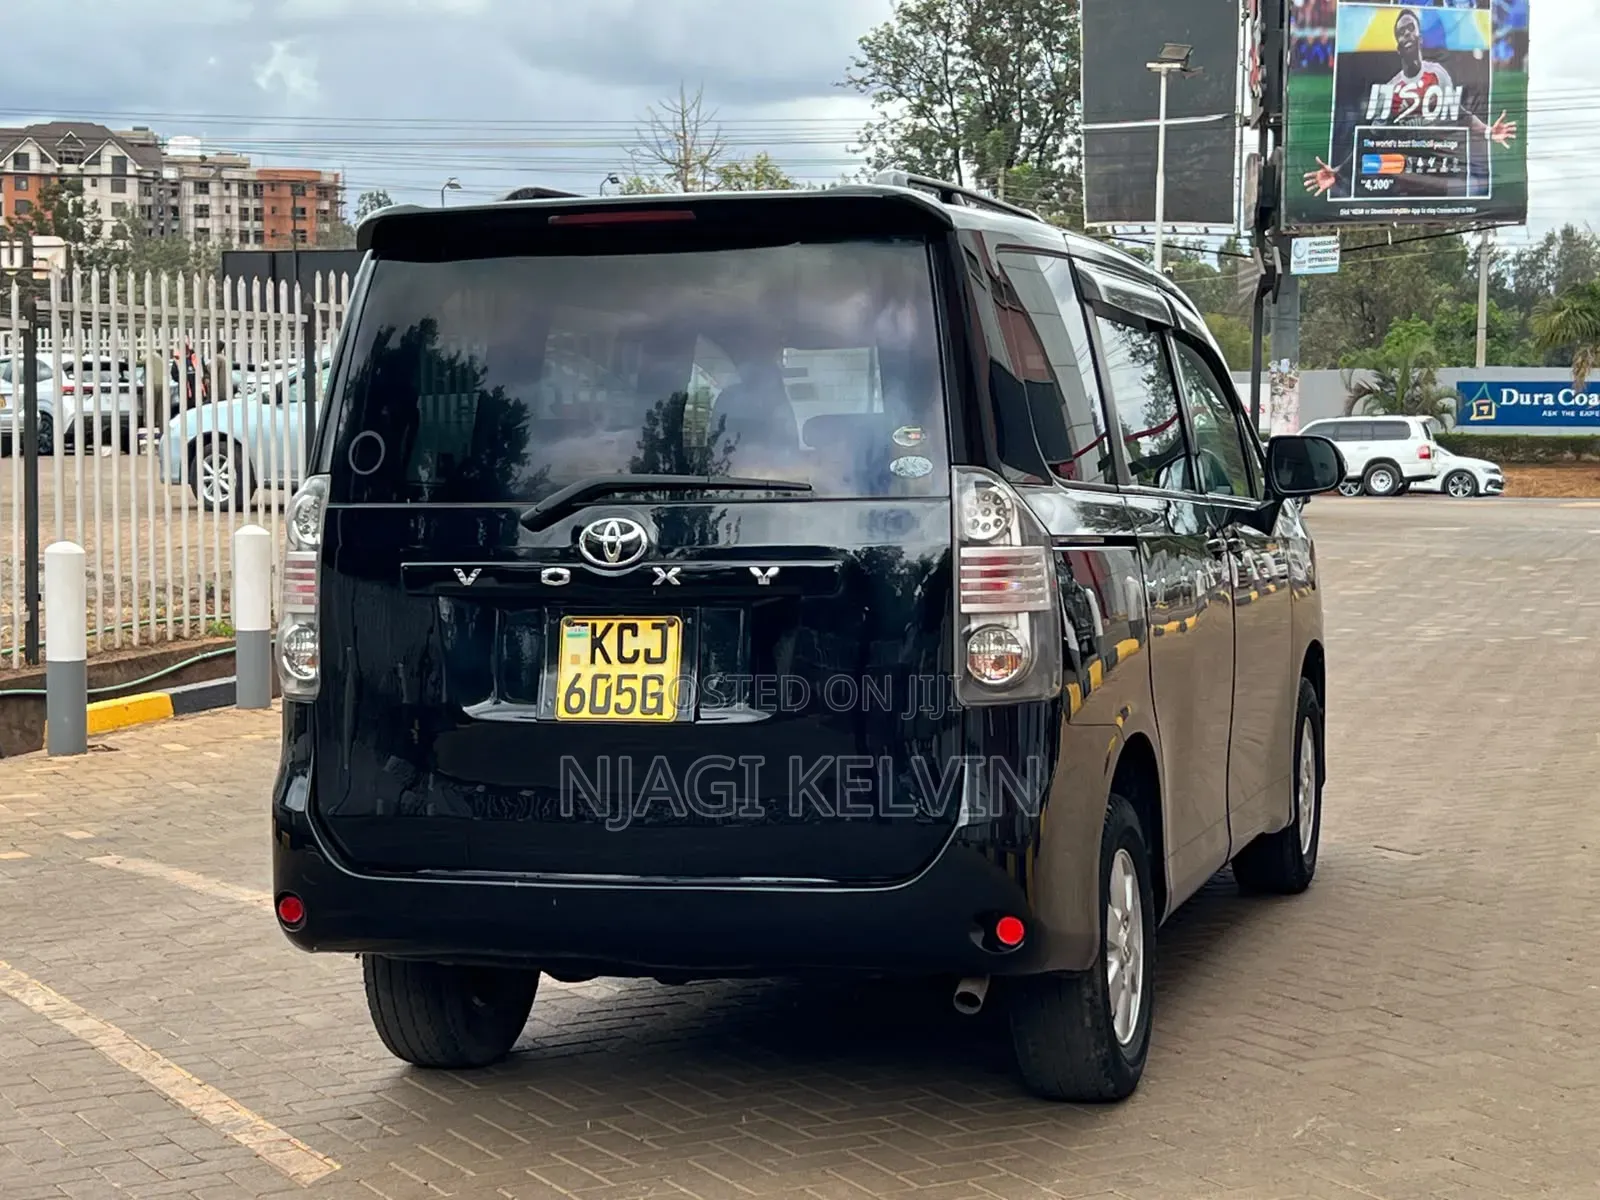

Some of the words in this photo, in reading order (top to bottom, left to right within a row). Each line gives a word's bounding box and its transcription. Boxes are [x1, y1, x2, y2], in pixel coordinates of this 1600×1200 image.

[1422, 84, 1463, 121] ON
[1500, 388, 1555, 406] Dura
[453, 567, 780, 586] VOXY
[589, 622, 669, 665] KCJ
[563, 673, 664, 716] 605G
